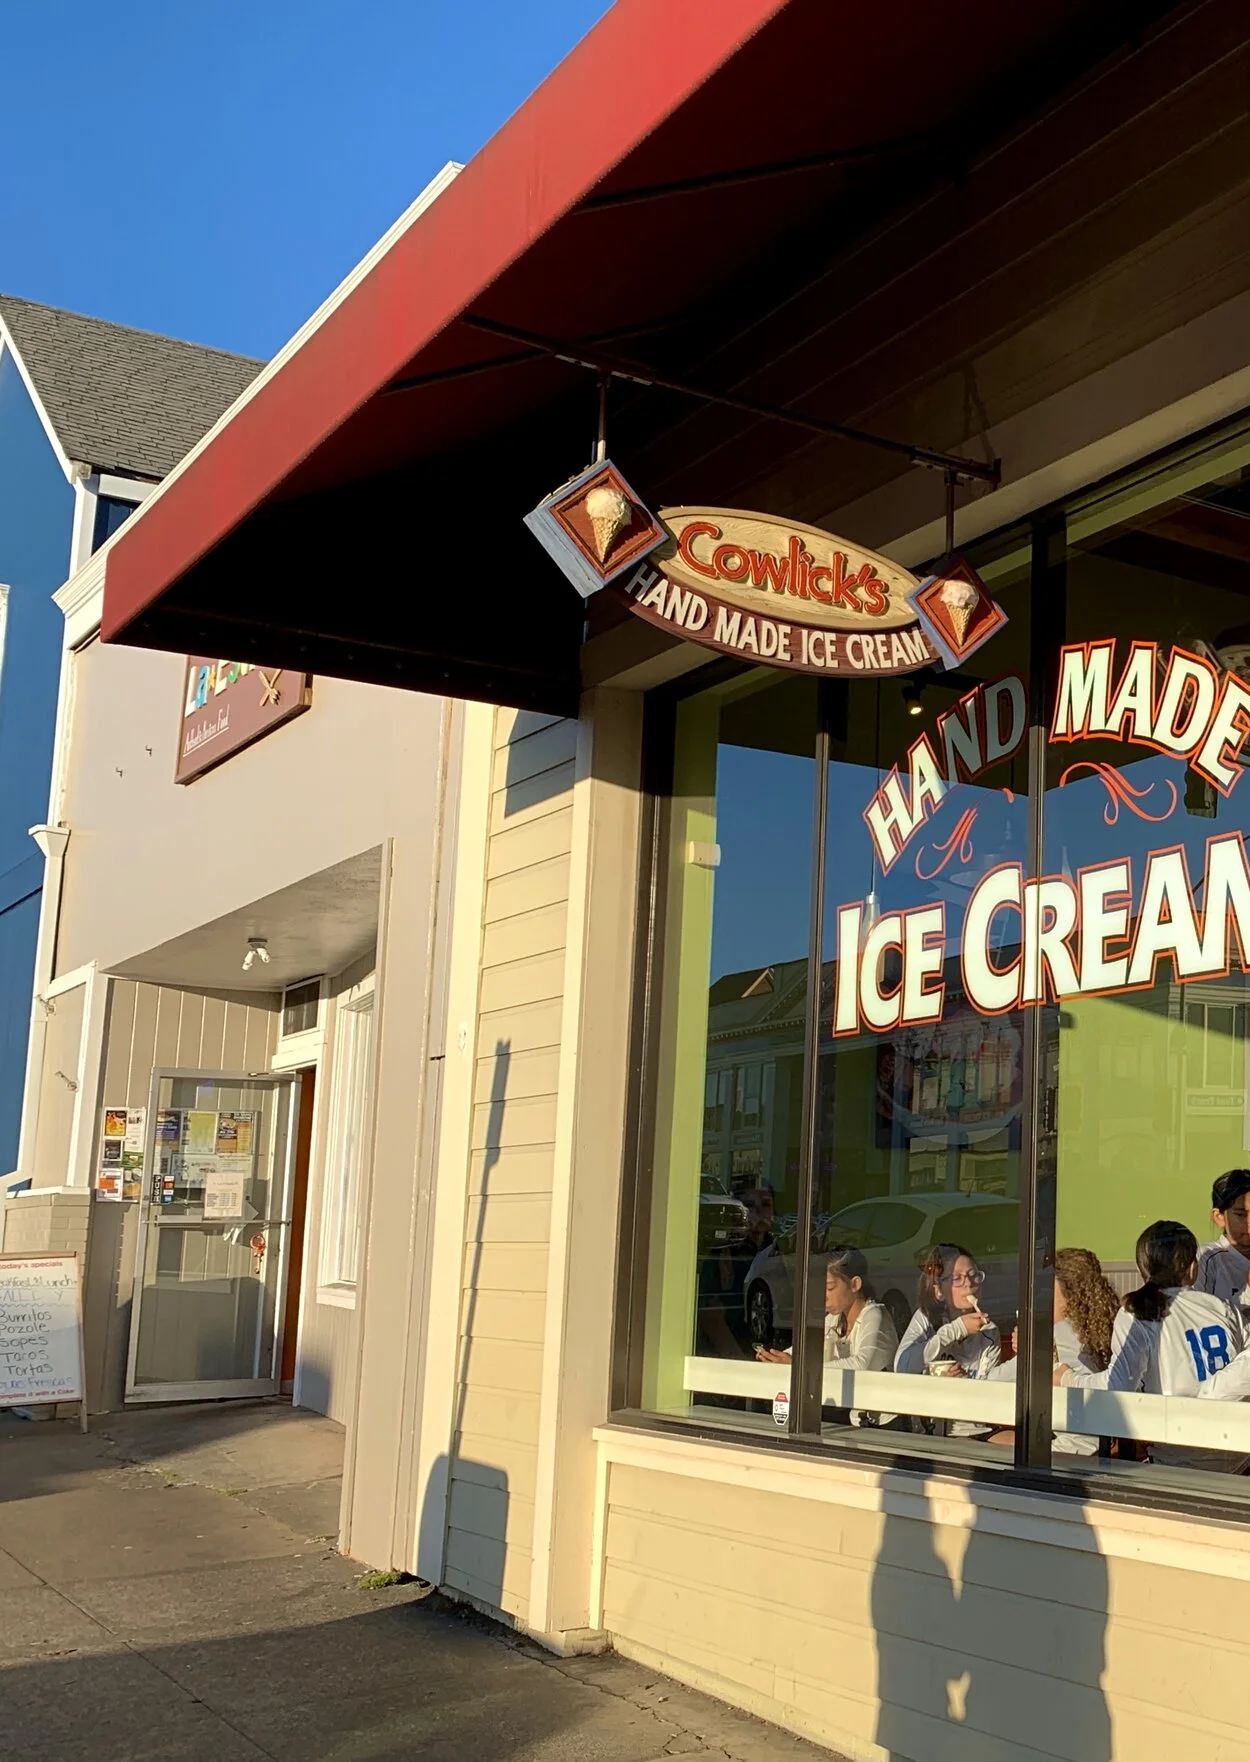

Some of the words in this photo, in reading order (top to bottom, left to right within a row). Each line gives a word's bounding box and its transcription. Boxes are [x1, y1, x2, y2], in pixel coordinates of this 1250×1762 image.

[677, 522, 889, 616] Cowlick's
[624, 564, 709, 631] HAND
[713, 606, 792, 663] MADE
[801, 629, 839, 668] ICE
[846, 627, 931, 670] CREAM
[863, 673, 1029, 876] HAND
[833, 901, 946, 1037] ICE
[31, 1261, 63, 1269] specials
[4, 1363, 53, 1376] Tortas
[1185, 1324, 1231, 1382] 18
